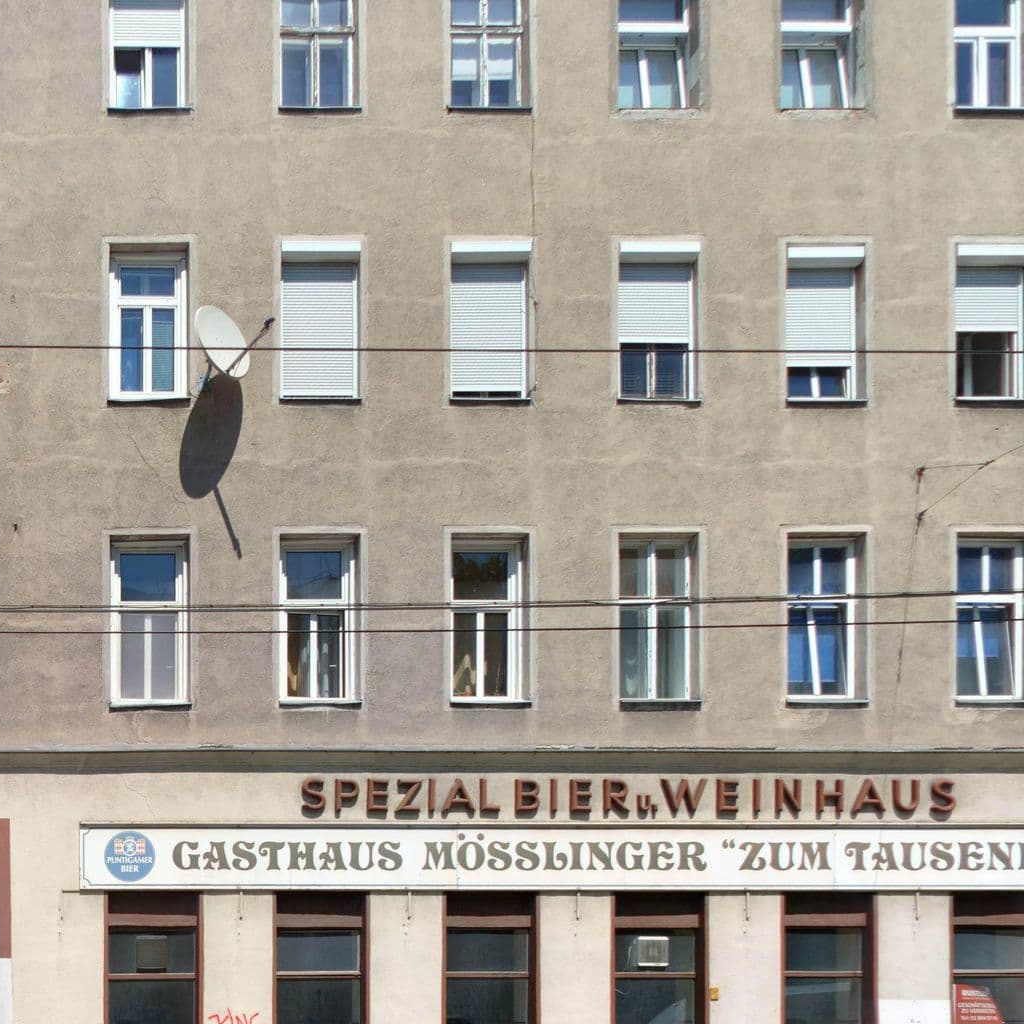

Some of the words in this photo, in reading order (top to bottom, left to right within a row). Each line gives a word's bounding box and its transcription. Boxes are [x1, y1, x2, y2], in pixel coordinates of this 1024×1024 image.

[660, 778, 957, 820] WEINHAUS
[106, 856, 153, 864] PUNTIGAMER
[172, 841, 403, 871] GASTHAUS
[422, 833, 707, 871] MÖSSLINGER
[120, 864, 139, 873] BIER
